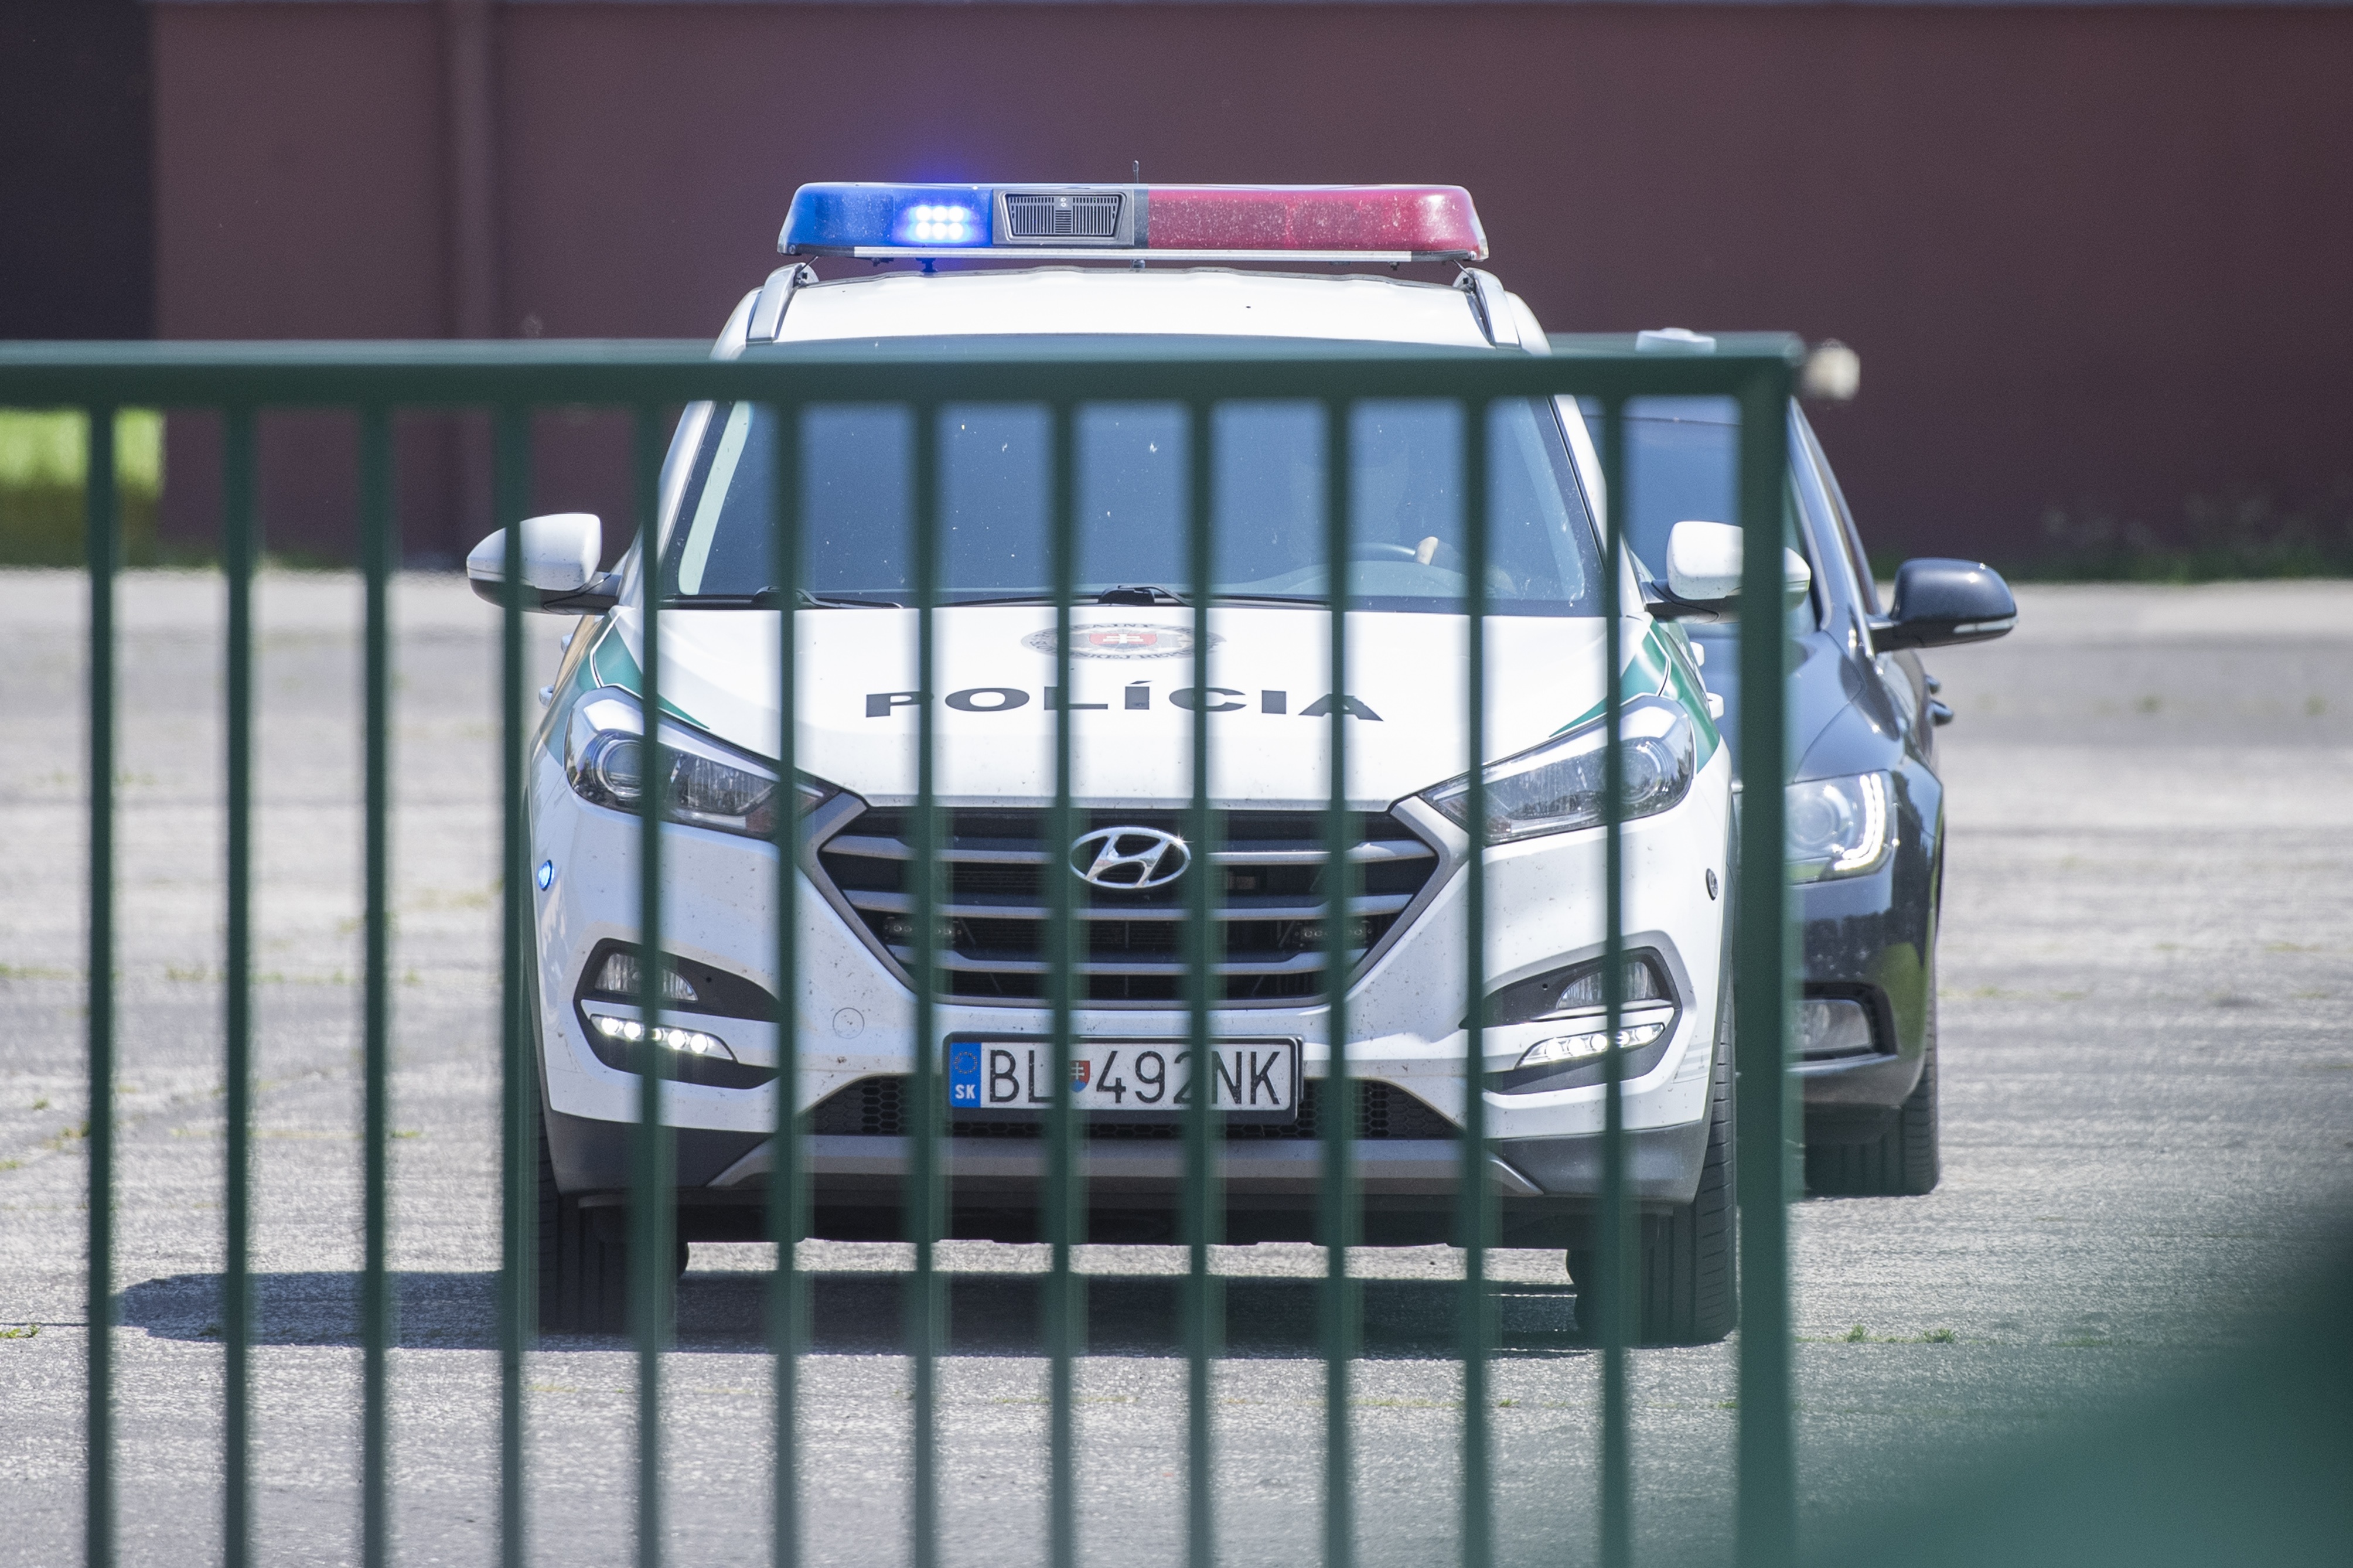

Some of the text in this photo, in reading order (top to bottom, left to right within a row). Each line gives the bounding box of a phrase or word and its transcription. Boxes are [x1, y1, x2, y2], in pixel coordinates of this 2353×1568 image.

[866, 680, 1384, 721] POLÍCIA
[956, 1084, 976, 1099] SK
[990, 1049, 1057, 1103] BL
